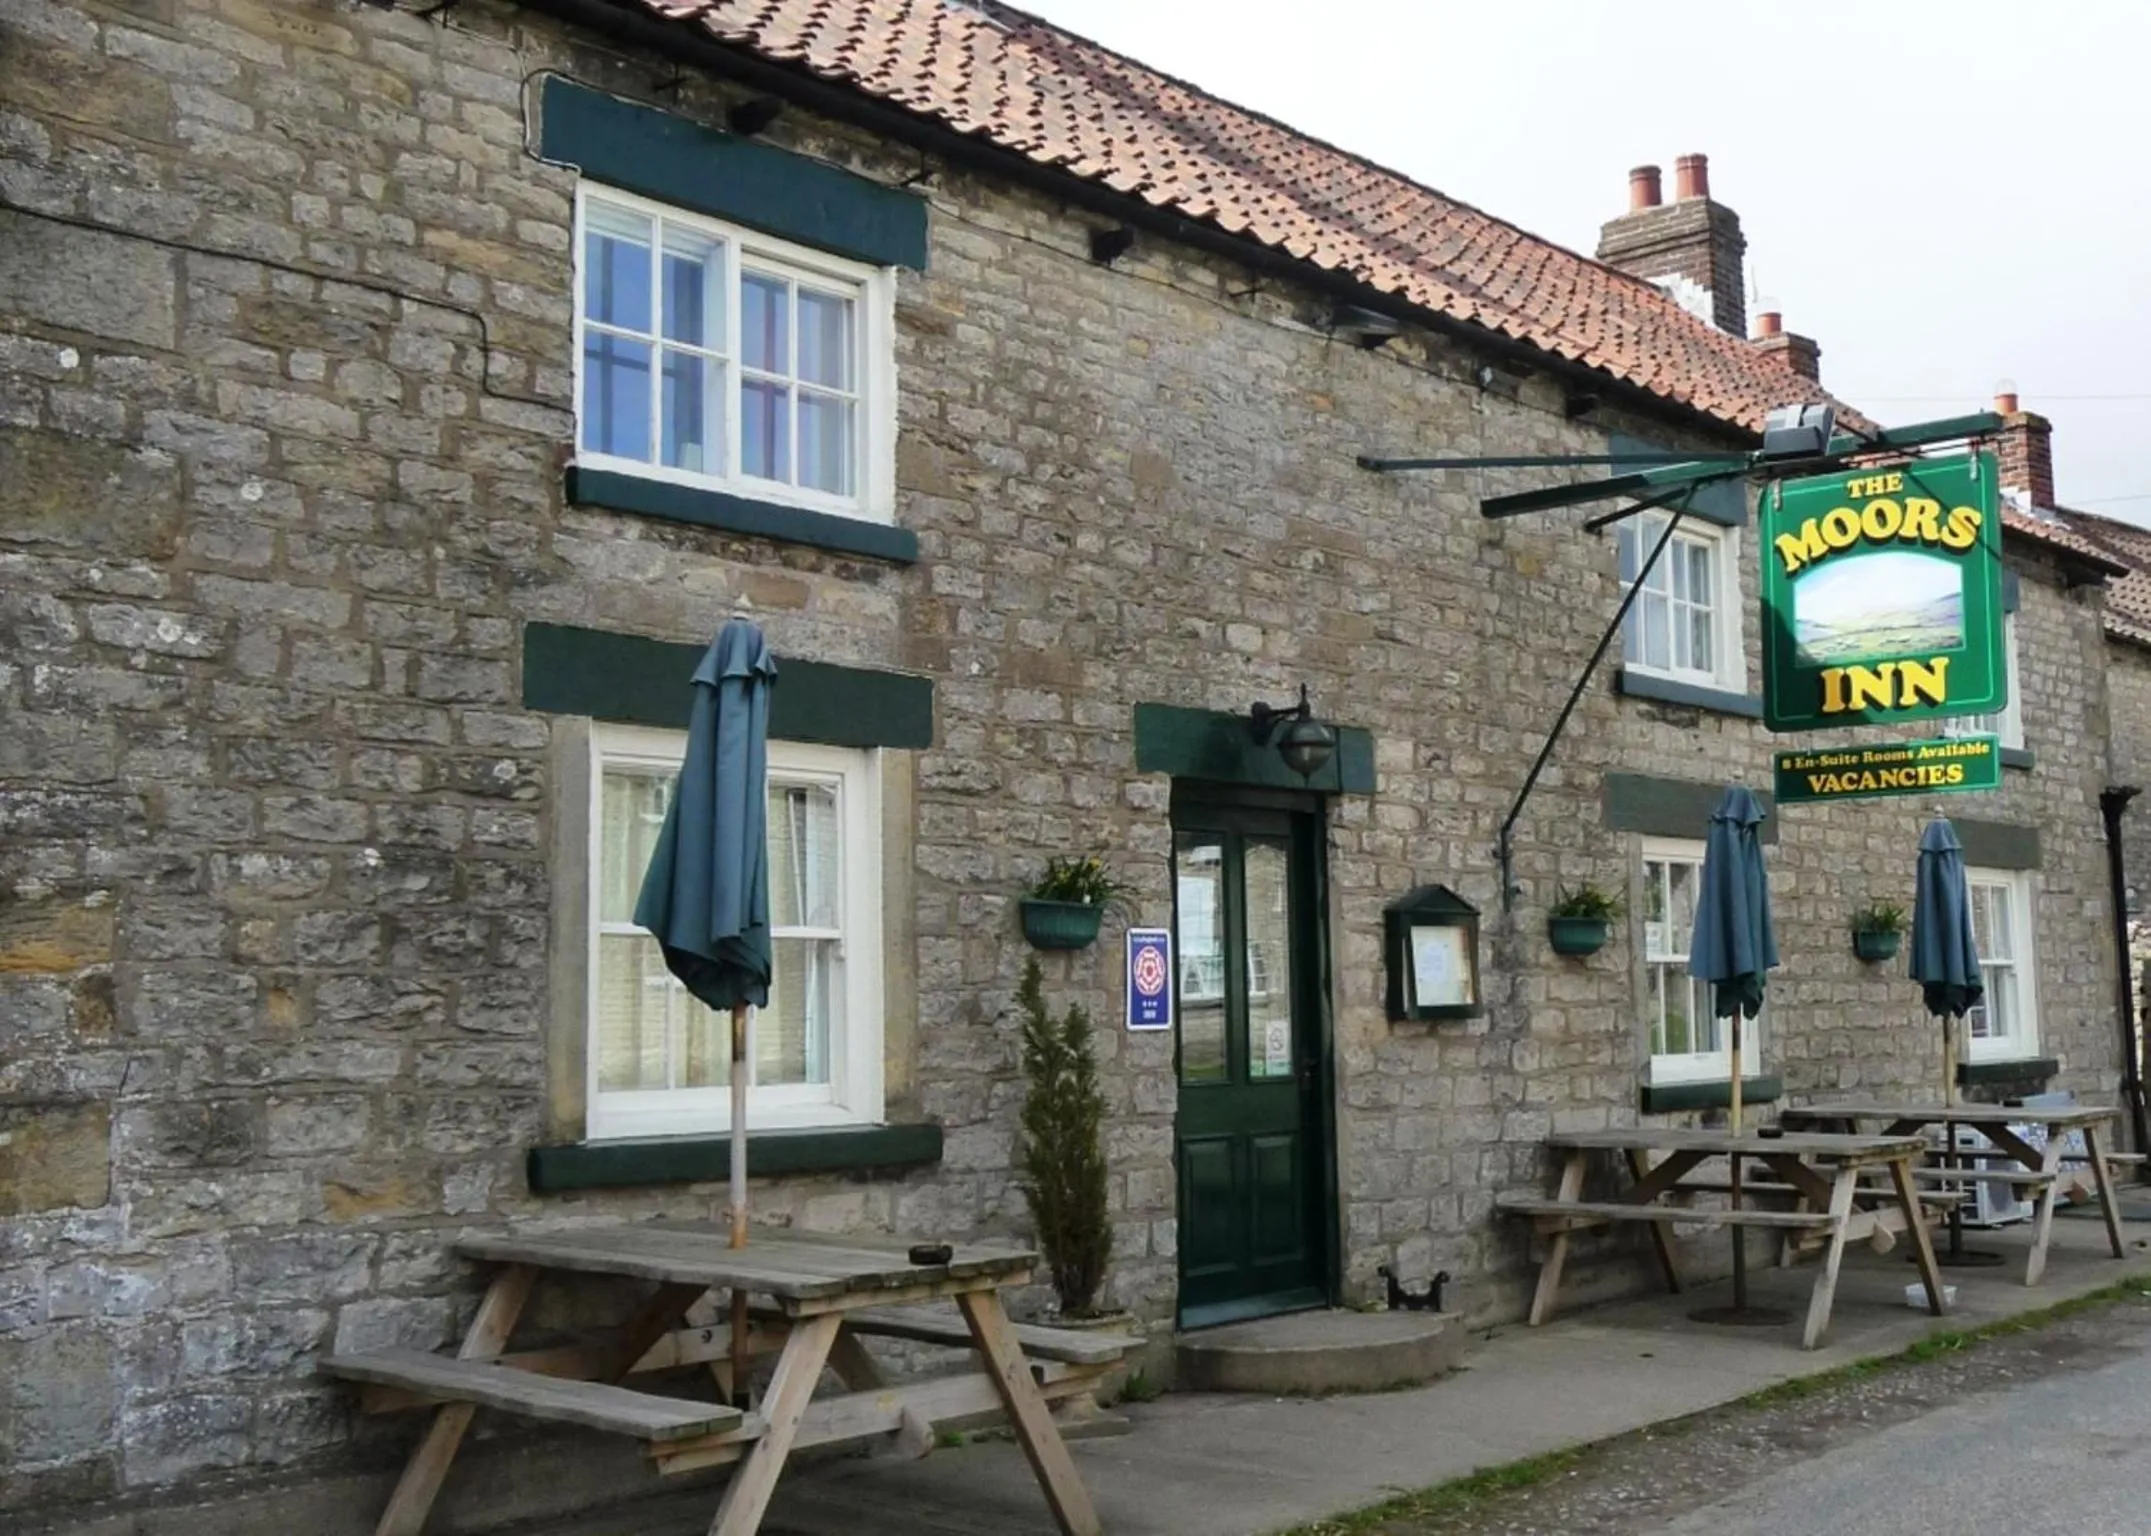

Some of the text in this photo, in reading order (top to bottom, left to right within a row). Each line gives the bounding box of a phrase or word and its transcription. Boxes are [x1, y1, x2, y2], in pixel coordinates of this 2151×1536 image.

[1847, 473, 1903, 498] THE
[1775, 498, 1981, 571] MOORS
[1821, 657, 1949, 712] INN
[1795, 753, 1859, 768] En-Suite
[1863, 750, 1914, 763] Rooms
[1917, 742, 1989, 759] Available
[1808, 764, 1963, 792] VACANCIES
